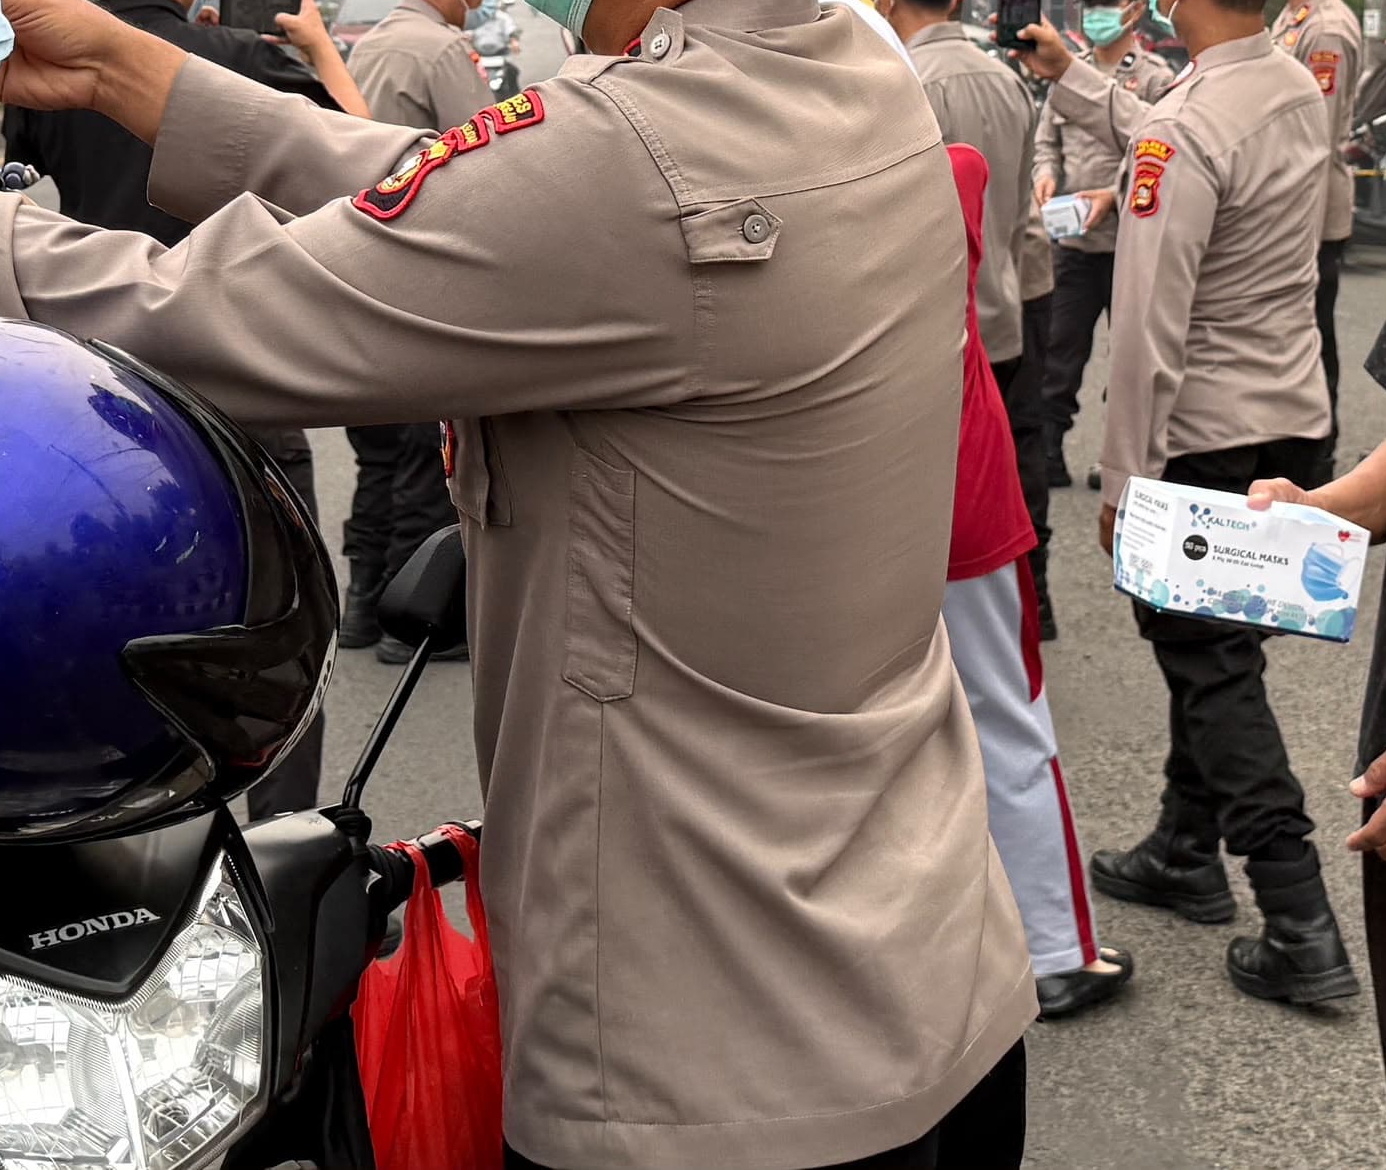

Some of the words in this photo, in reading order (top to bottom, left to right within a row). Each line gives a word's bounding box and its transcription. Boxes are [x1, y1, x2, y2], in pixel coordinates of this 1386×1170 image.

[1213, 544, 1257, 561] SURGICAL
[1258, 552, 1289, 567] MASKS
[28, 907, 162, 950] HONDA
